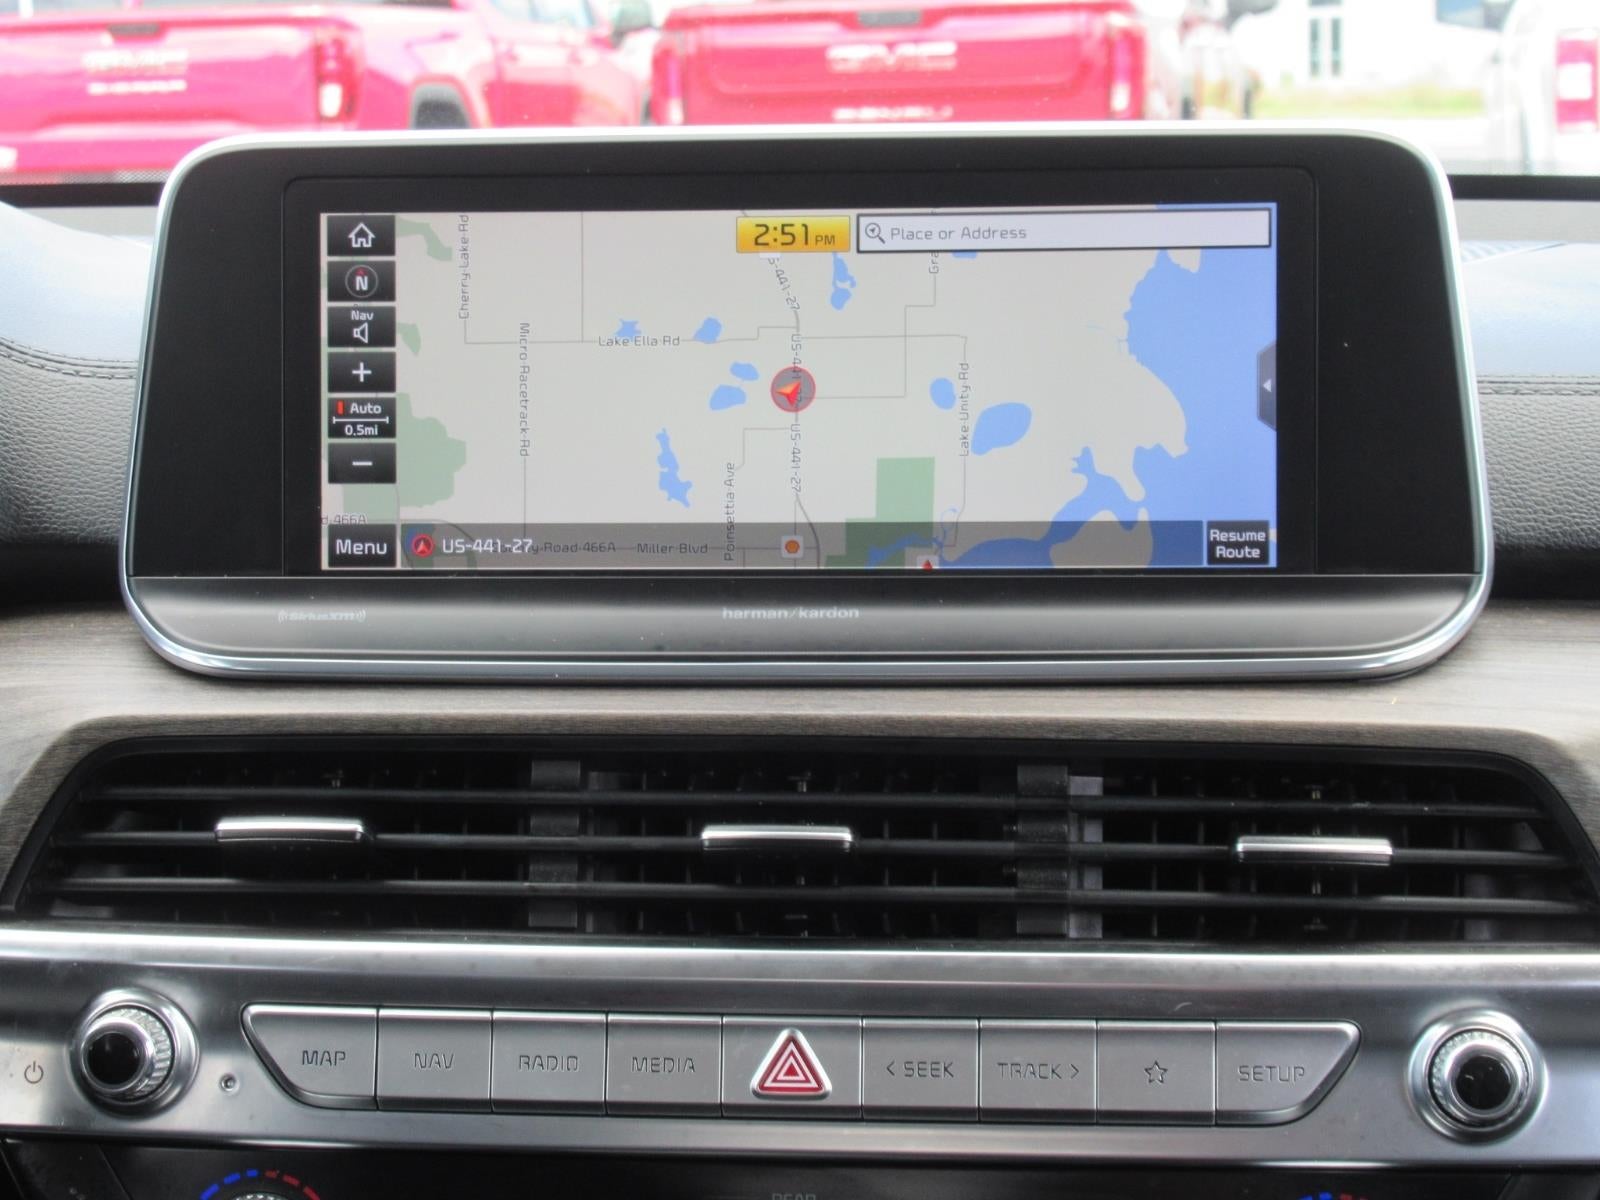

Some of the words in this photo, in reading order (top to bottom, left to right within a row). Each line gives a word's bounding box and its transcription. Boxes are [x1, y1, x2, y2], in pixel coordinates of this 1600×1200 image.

[459, 214, 470, 232] Rd
[754, 223, 809, 246] 2:51
[815, 235, 836, 246] PM
[890, 227, 933, 241] Place
[938, 230, 955, 240] or
[960, 226, 1027, 240] Address
[459, 237, 470, 268] Lake
[356, 275, 368, 291] N
[459, 272, 471, 320] Cherry
[350, 310, 374, 321] Nav
[519, 322, 530, 361] Micro
[598, 335, 630, 347] Lake
[634, 335, 658, 347] Ella
[662, 335, 680, 347] Rd
[958, 362, 970, 380] Rd
[350, 402, 382, 414] Auto
[519, 365, 530, 434] Racetrack
[959, 384, 972, 421] Unity
[344, 424, 379, 437] 0.5mi
[519, 439, 530, 457] Rd
[959, 424, 970, 457] Lake
[791, 423, 802, 493] US-441-27
[723, 461, 735, 488] Ave
[724, 491, 736, 561] Poinsettia
[1209, 529, 1266, 542] Resume
[336, 538, 388, 555] Menu
[442, 538, 534, 554] US-441-27
[544, 541, 578, 554] Road
[582, 541, 617, 553] 466A
[637, 542, 676, 554] Miller
[679, 542, 709, 554] Blvd
[1215, 545, 1261, 558] Route
[721, 606, 860, 620] harman/kardon
[301, 1049, 347, 1068] MAP
[413, 1052, 455, 1071] NAV
[518, 1054, 579, 1072] RADIO
[631, 1056, 697, 1074] MEDIA
[903, 1060, 955, 1079] SEEK
[997, 1062, 1062, 1081] TRACK
[1237, 1065, 1306, 1084] SETUP
